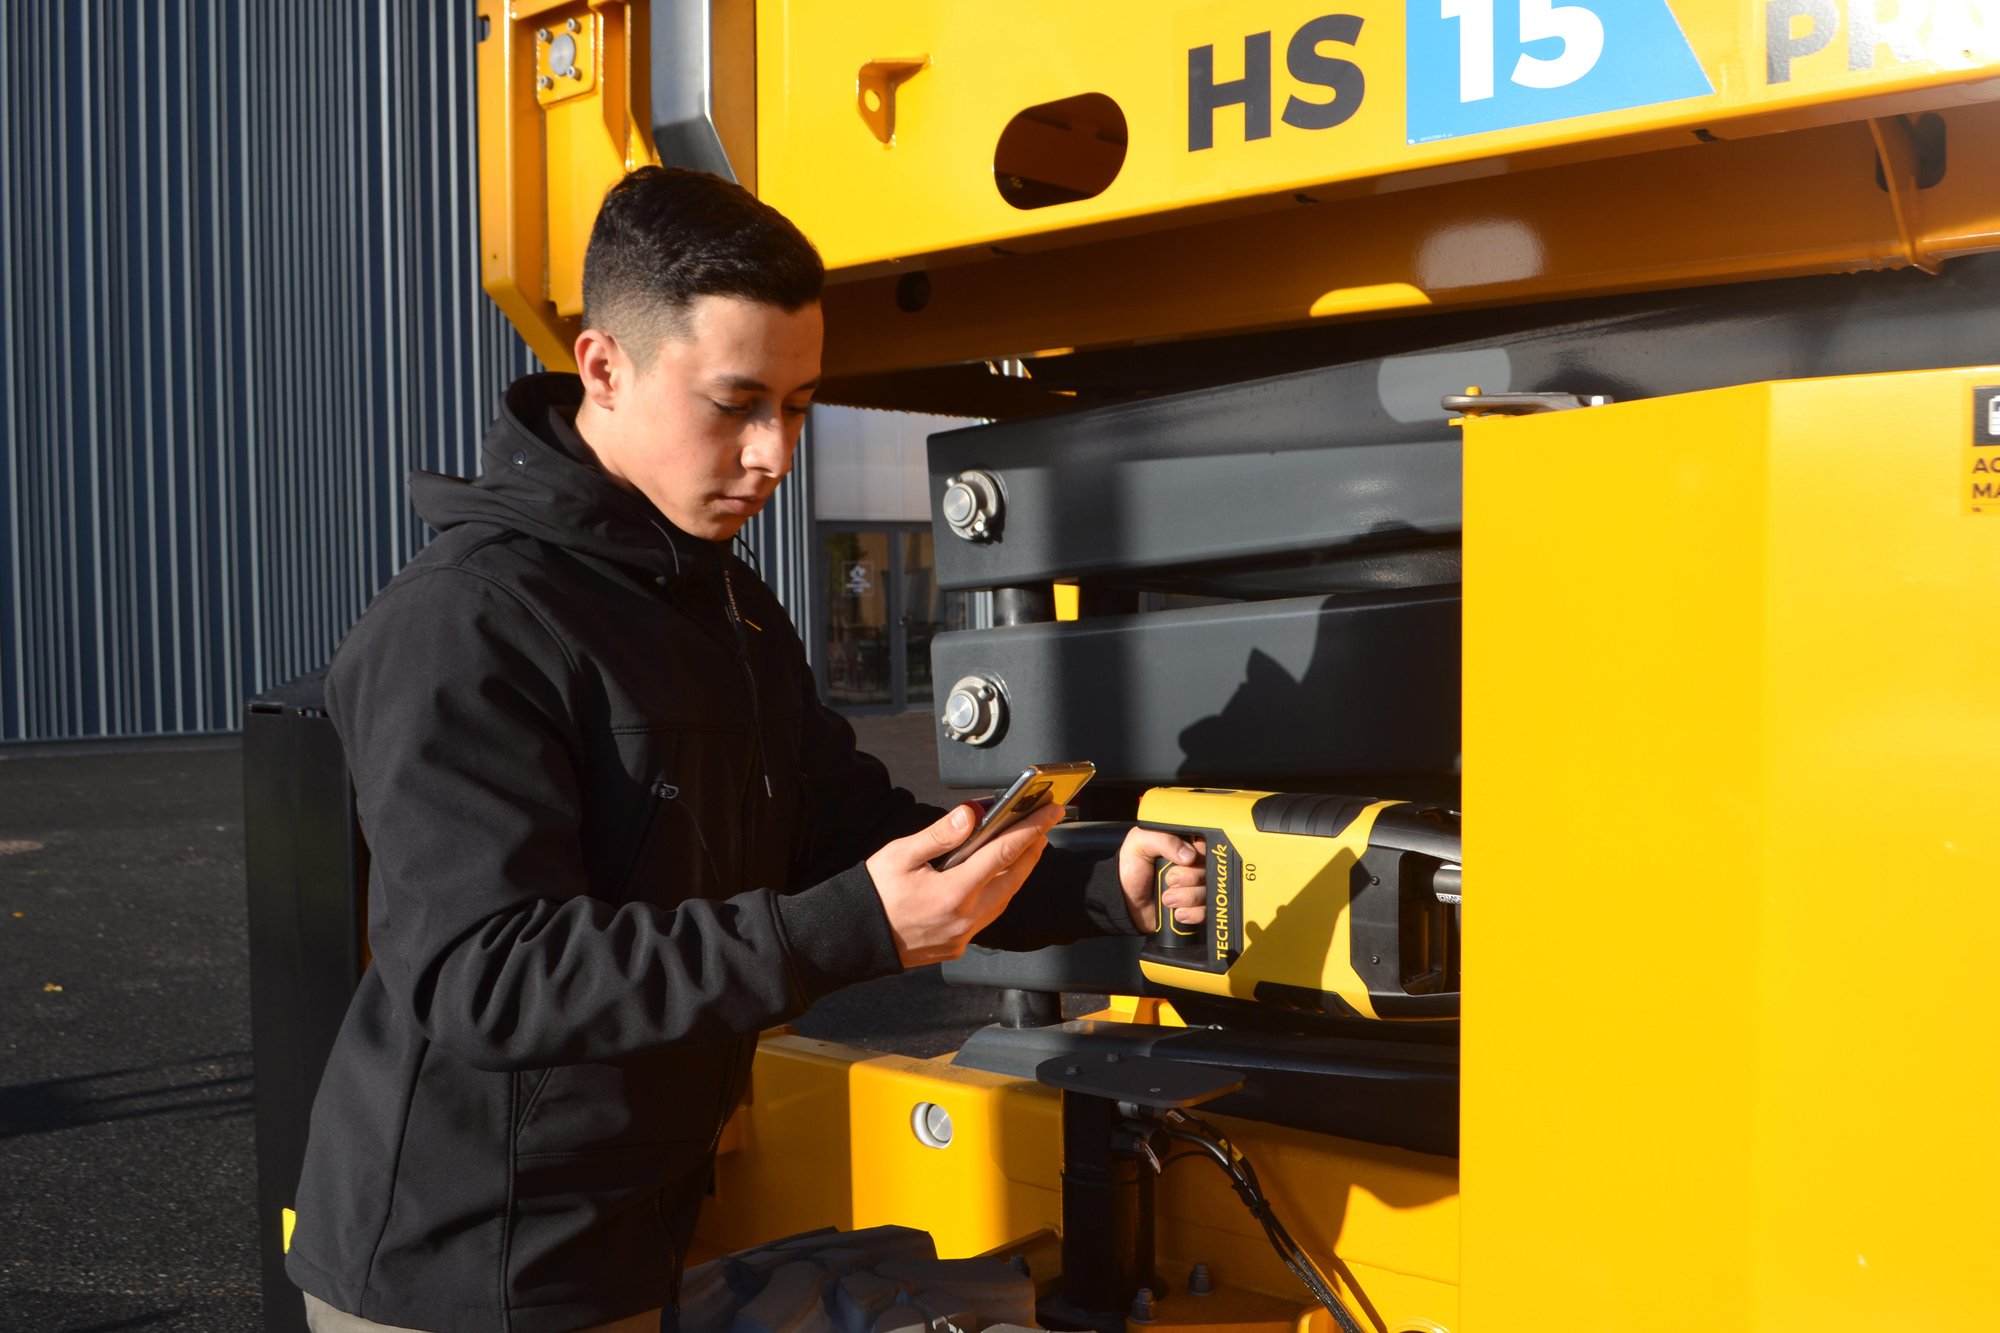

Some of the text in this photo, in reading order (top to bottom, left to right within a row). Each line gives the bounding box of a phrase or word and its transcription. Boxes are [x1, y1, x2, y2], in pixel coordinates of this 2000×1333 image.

[1188, 13, 1365, 152] HS
[1440, 0, 1605, 103] 15
[1211, 843, 1229, 961] TECHNOmark
[1245, 863, 1257, 882] 60
